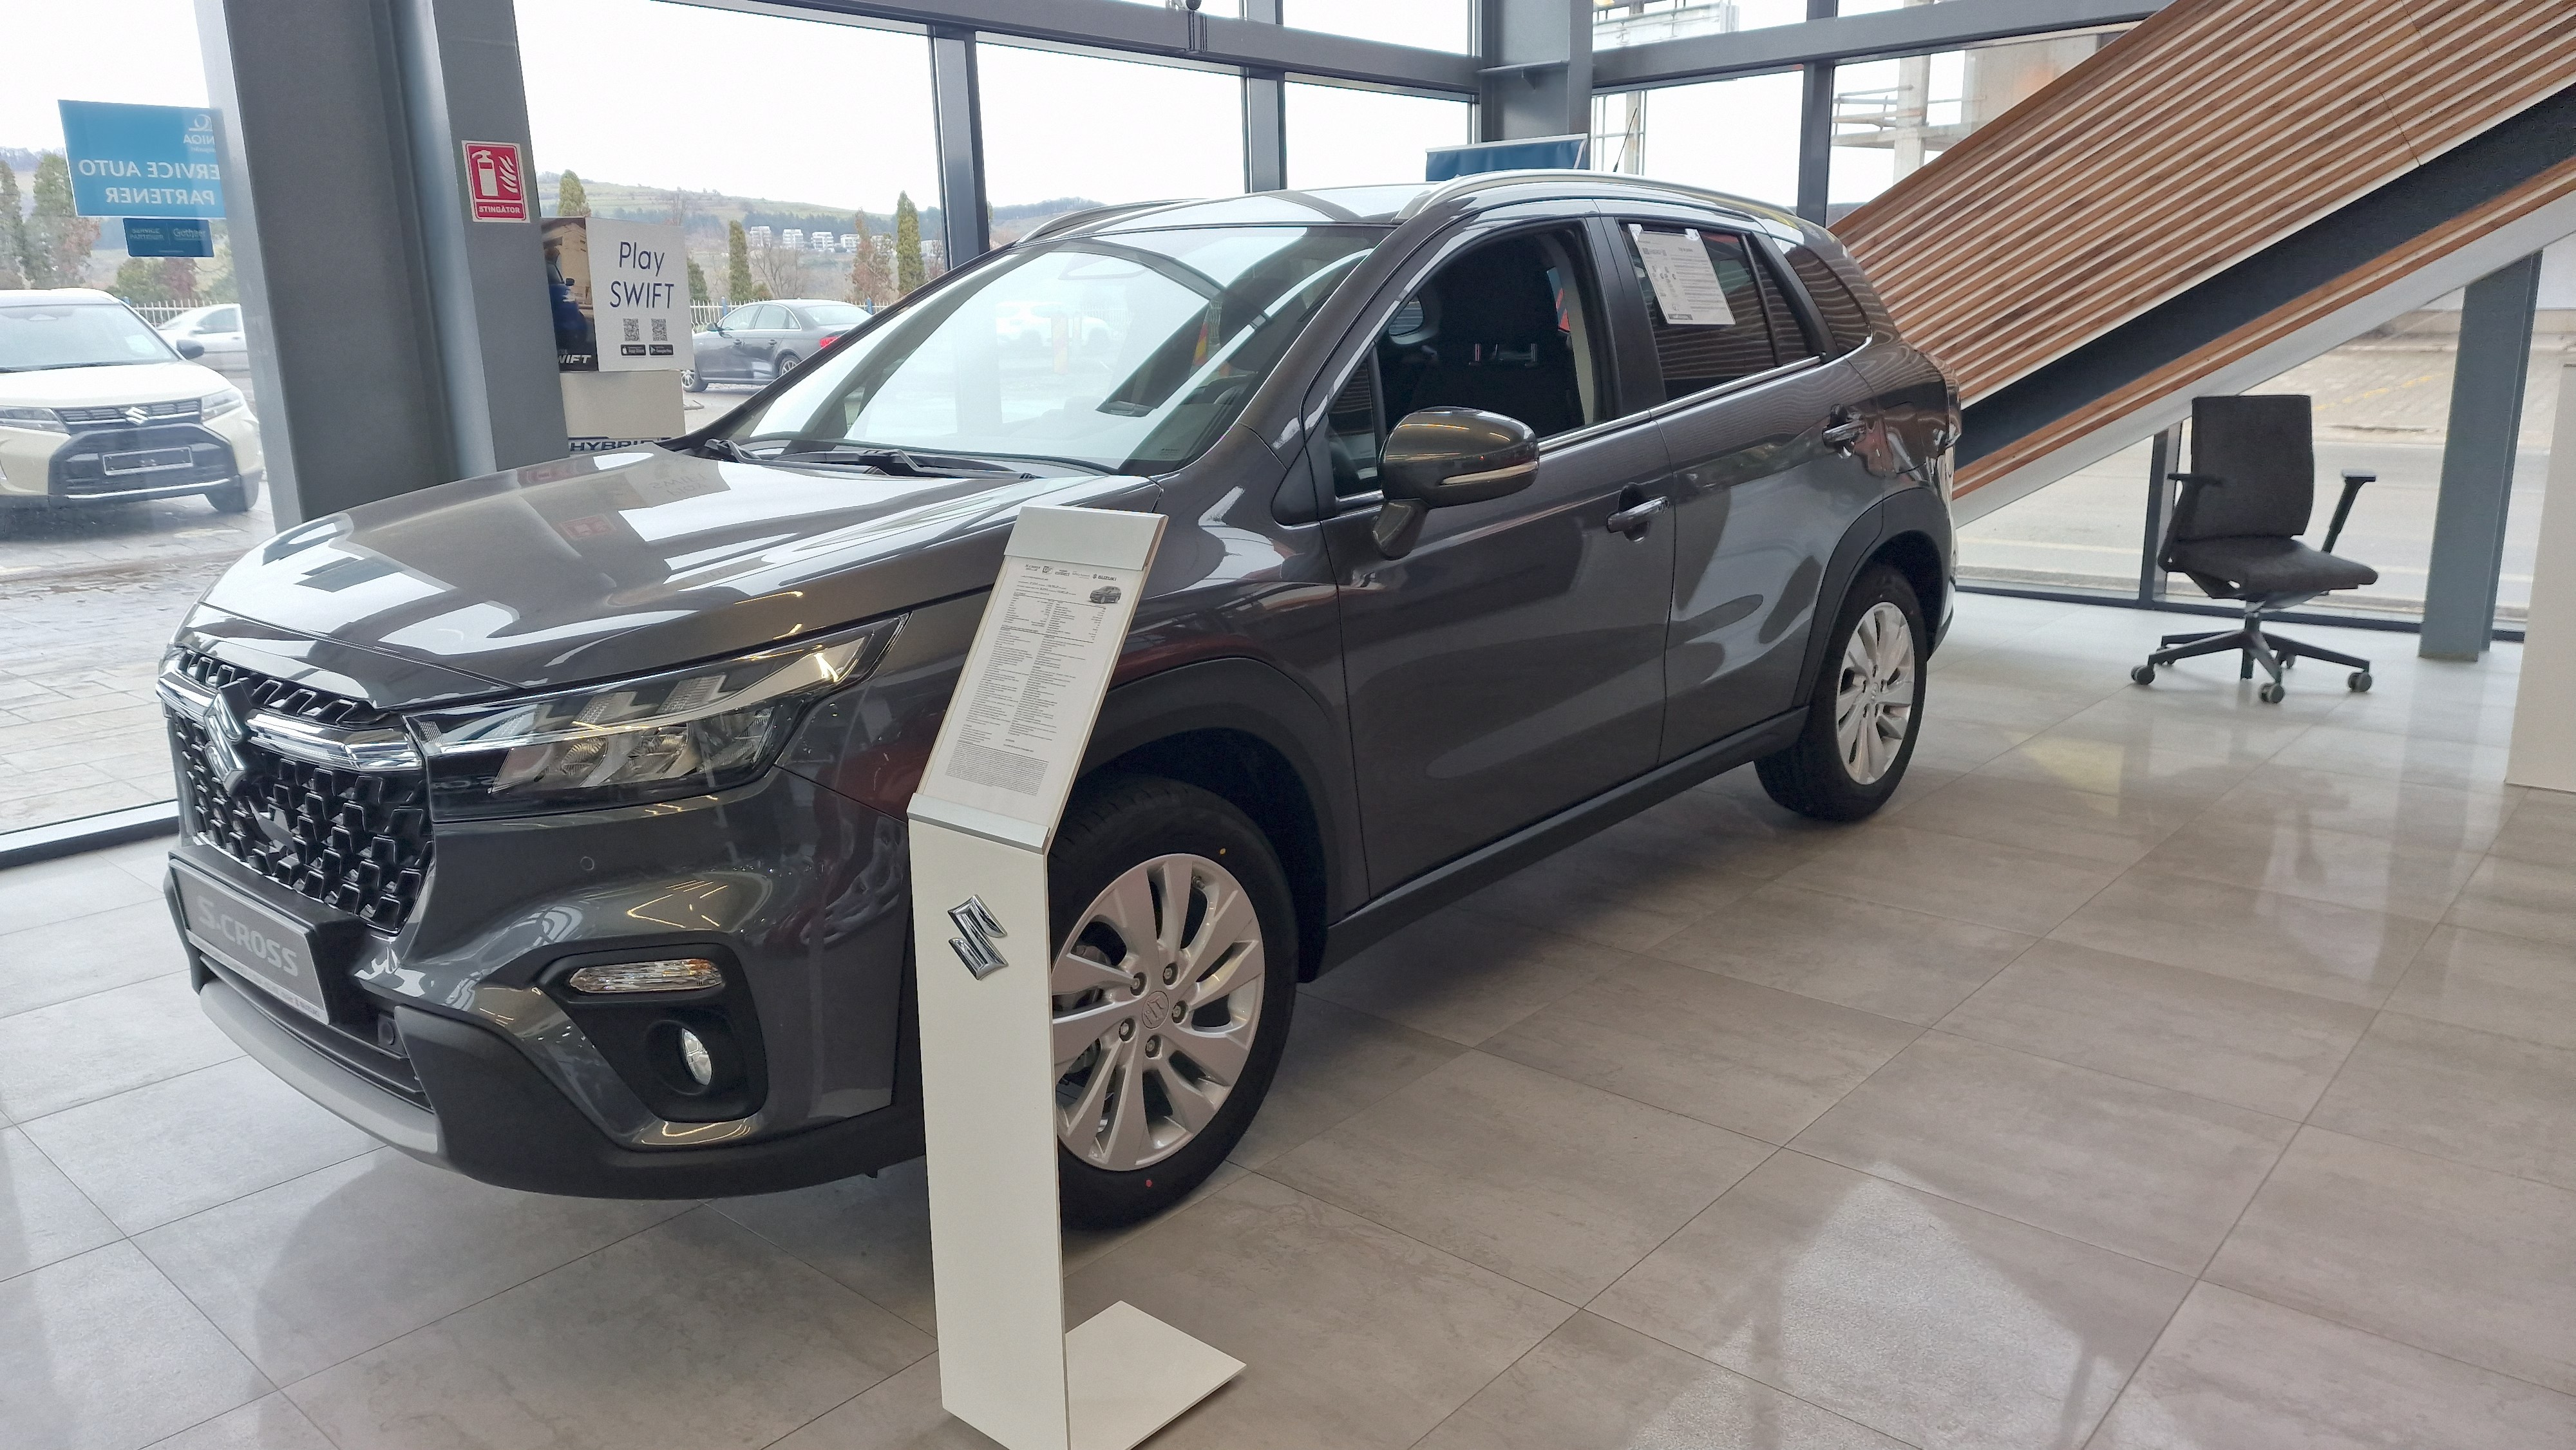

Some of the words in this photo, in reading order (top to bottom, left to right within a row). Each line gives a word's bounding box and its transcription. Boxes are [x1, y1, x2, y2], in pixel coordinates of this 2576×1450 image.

[619, 241, 665, 277] Play
[610, 281, 674, 308] SWIFT
[558, 354, 592, 364] WIFT
